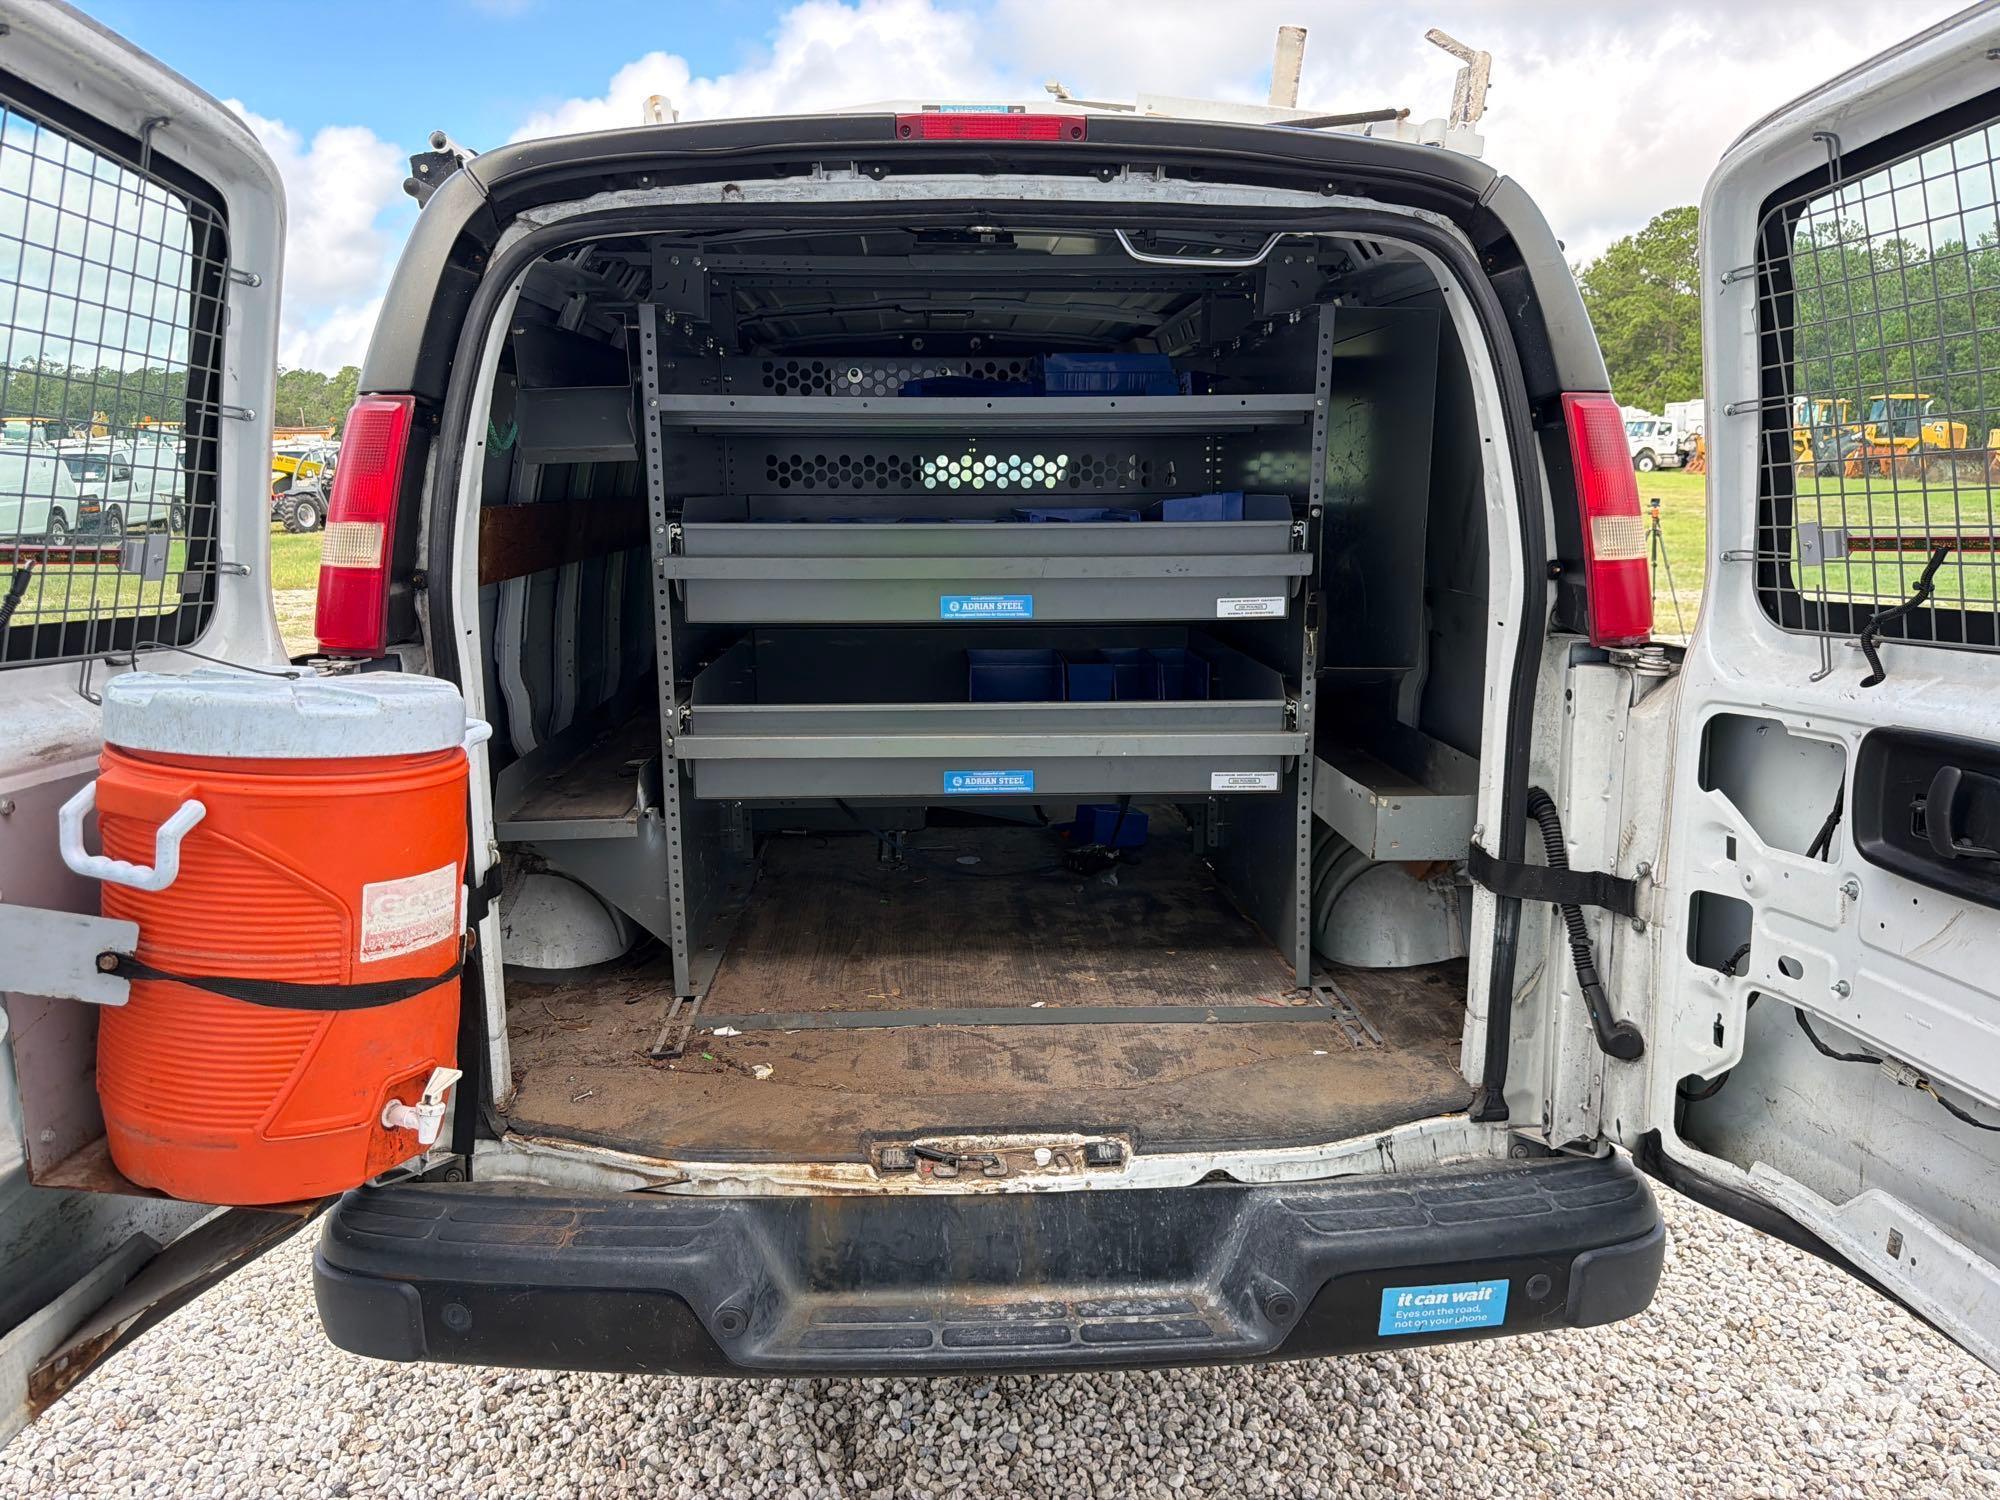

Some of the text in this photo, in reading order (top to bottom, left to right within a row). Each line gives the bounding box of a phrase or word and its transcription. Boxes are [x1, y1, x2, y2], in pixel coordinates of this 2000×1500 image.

[962, 602, 1023, 610] ADRIAN STEEL
[965, 777, 1024, 785] ADRIAN STEEL
[1397, 1287, 1493, 1307] it can wait
[1395, 1304, 1481, 1320] Eyes on the road,
[1394, 1314, 1488, 1328] not on your phone
